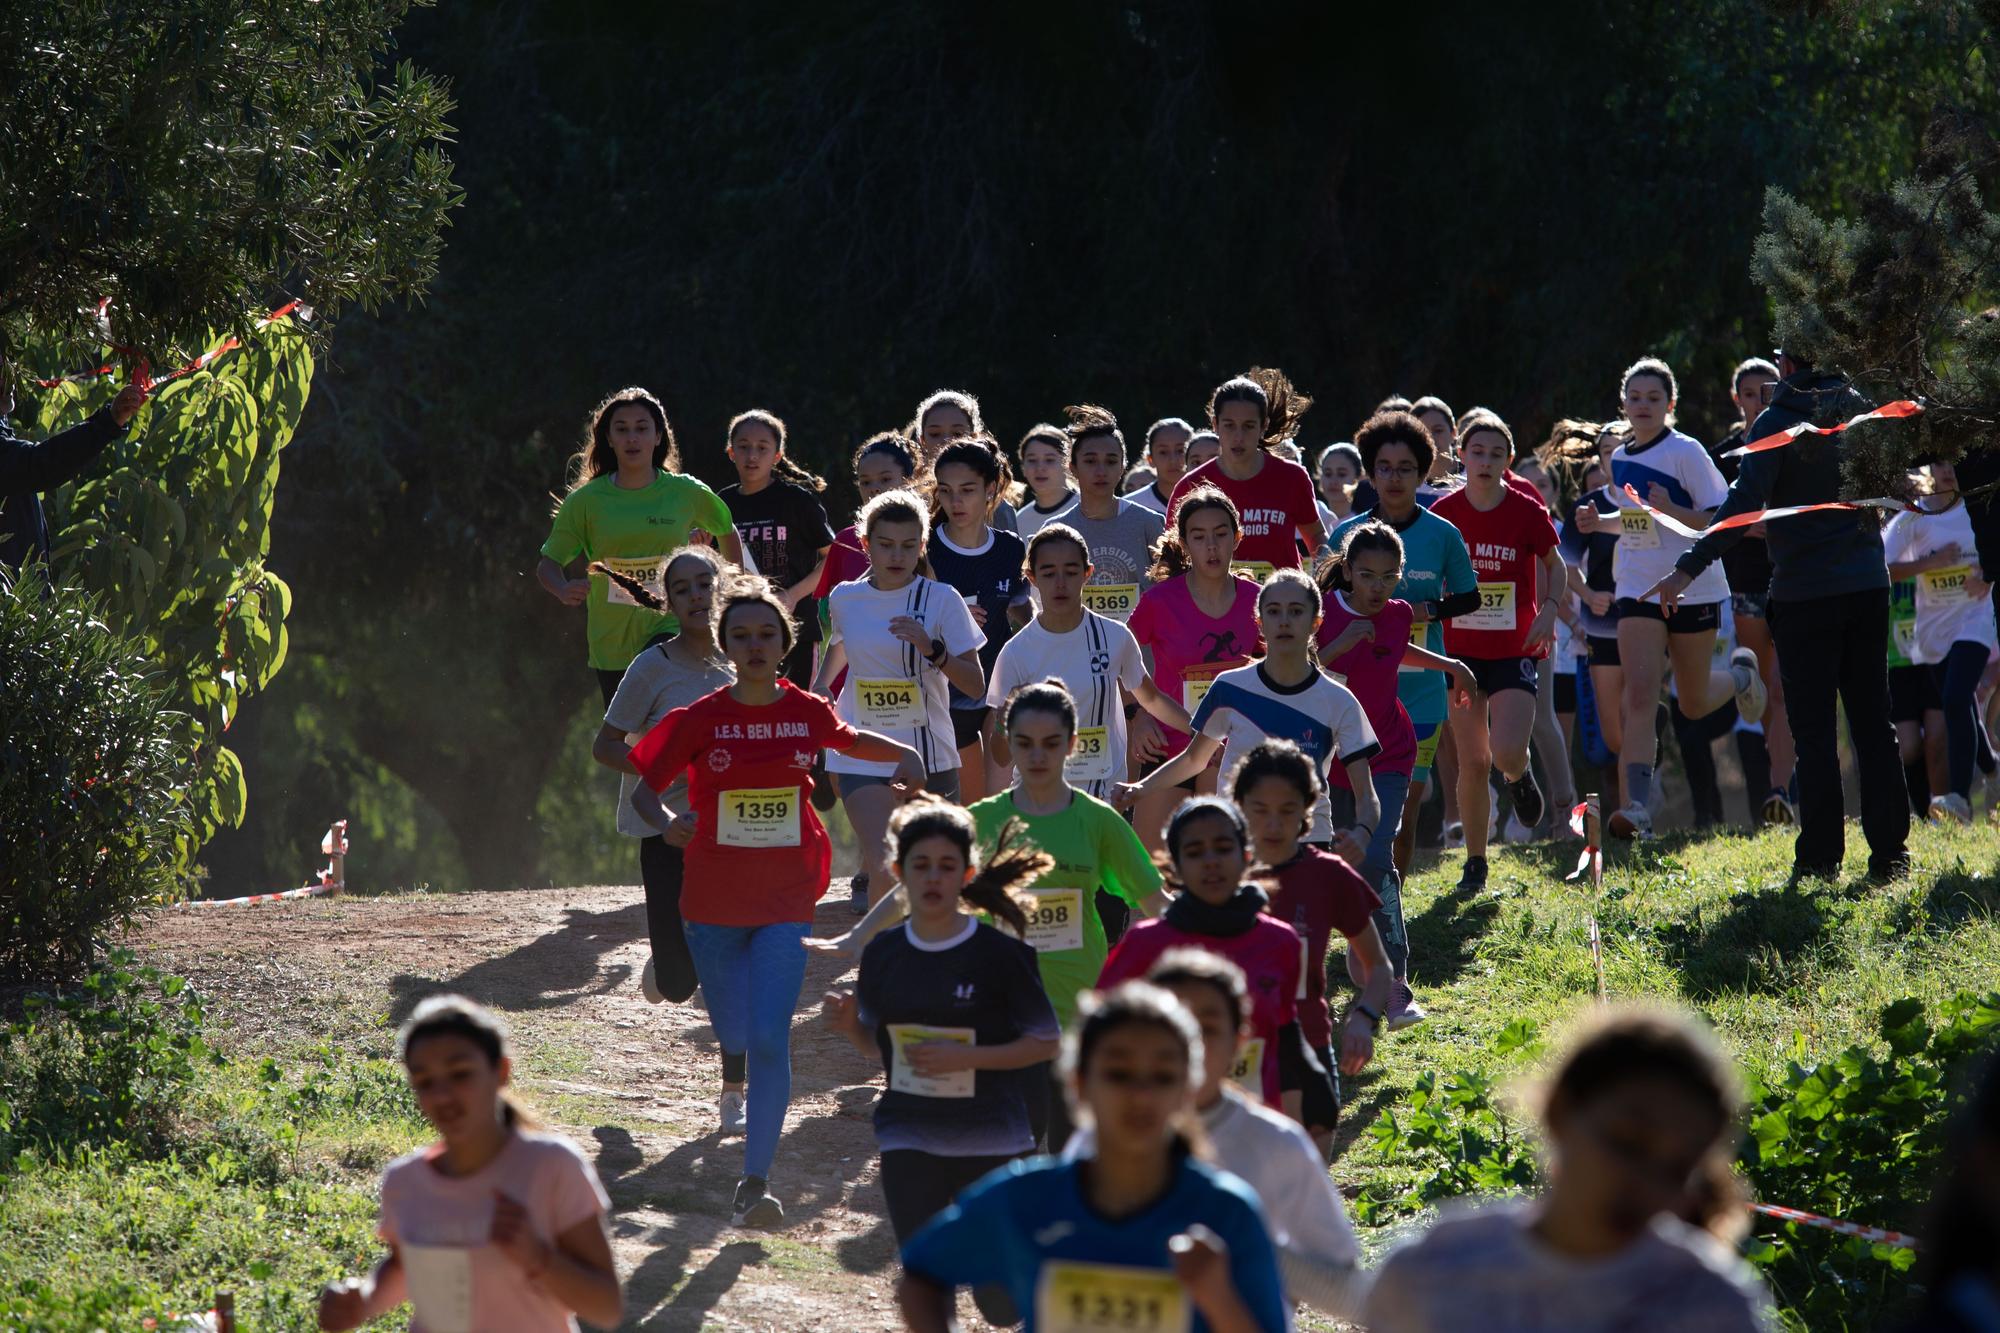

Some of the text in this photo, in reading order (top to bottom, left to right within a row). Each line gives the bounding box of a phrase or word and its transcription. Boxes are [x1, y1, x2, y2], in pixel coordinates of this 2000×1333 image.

[1243, 509, 1286, 525] MATER
[1622, 518, 1648, 530] 1412
[1090, 546, 1137, 572] ERSIDAD
[1476, 543, 1516, 561] MATER
[1085, 596, 1129, 609] 1369
[864, 691, 912, 706] 1304
[714, 721, 810, 740] I.E.S. BEN ARABI
[735, 802, 788, 819] 1359
[1028, 906, 1068, 925] 398
